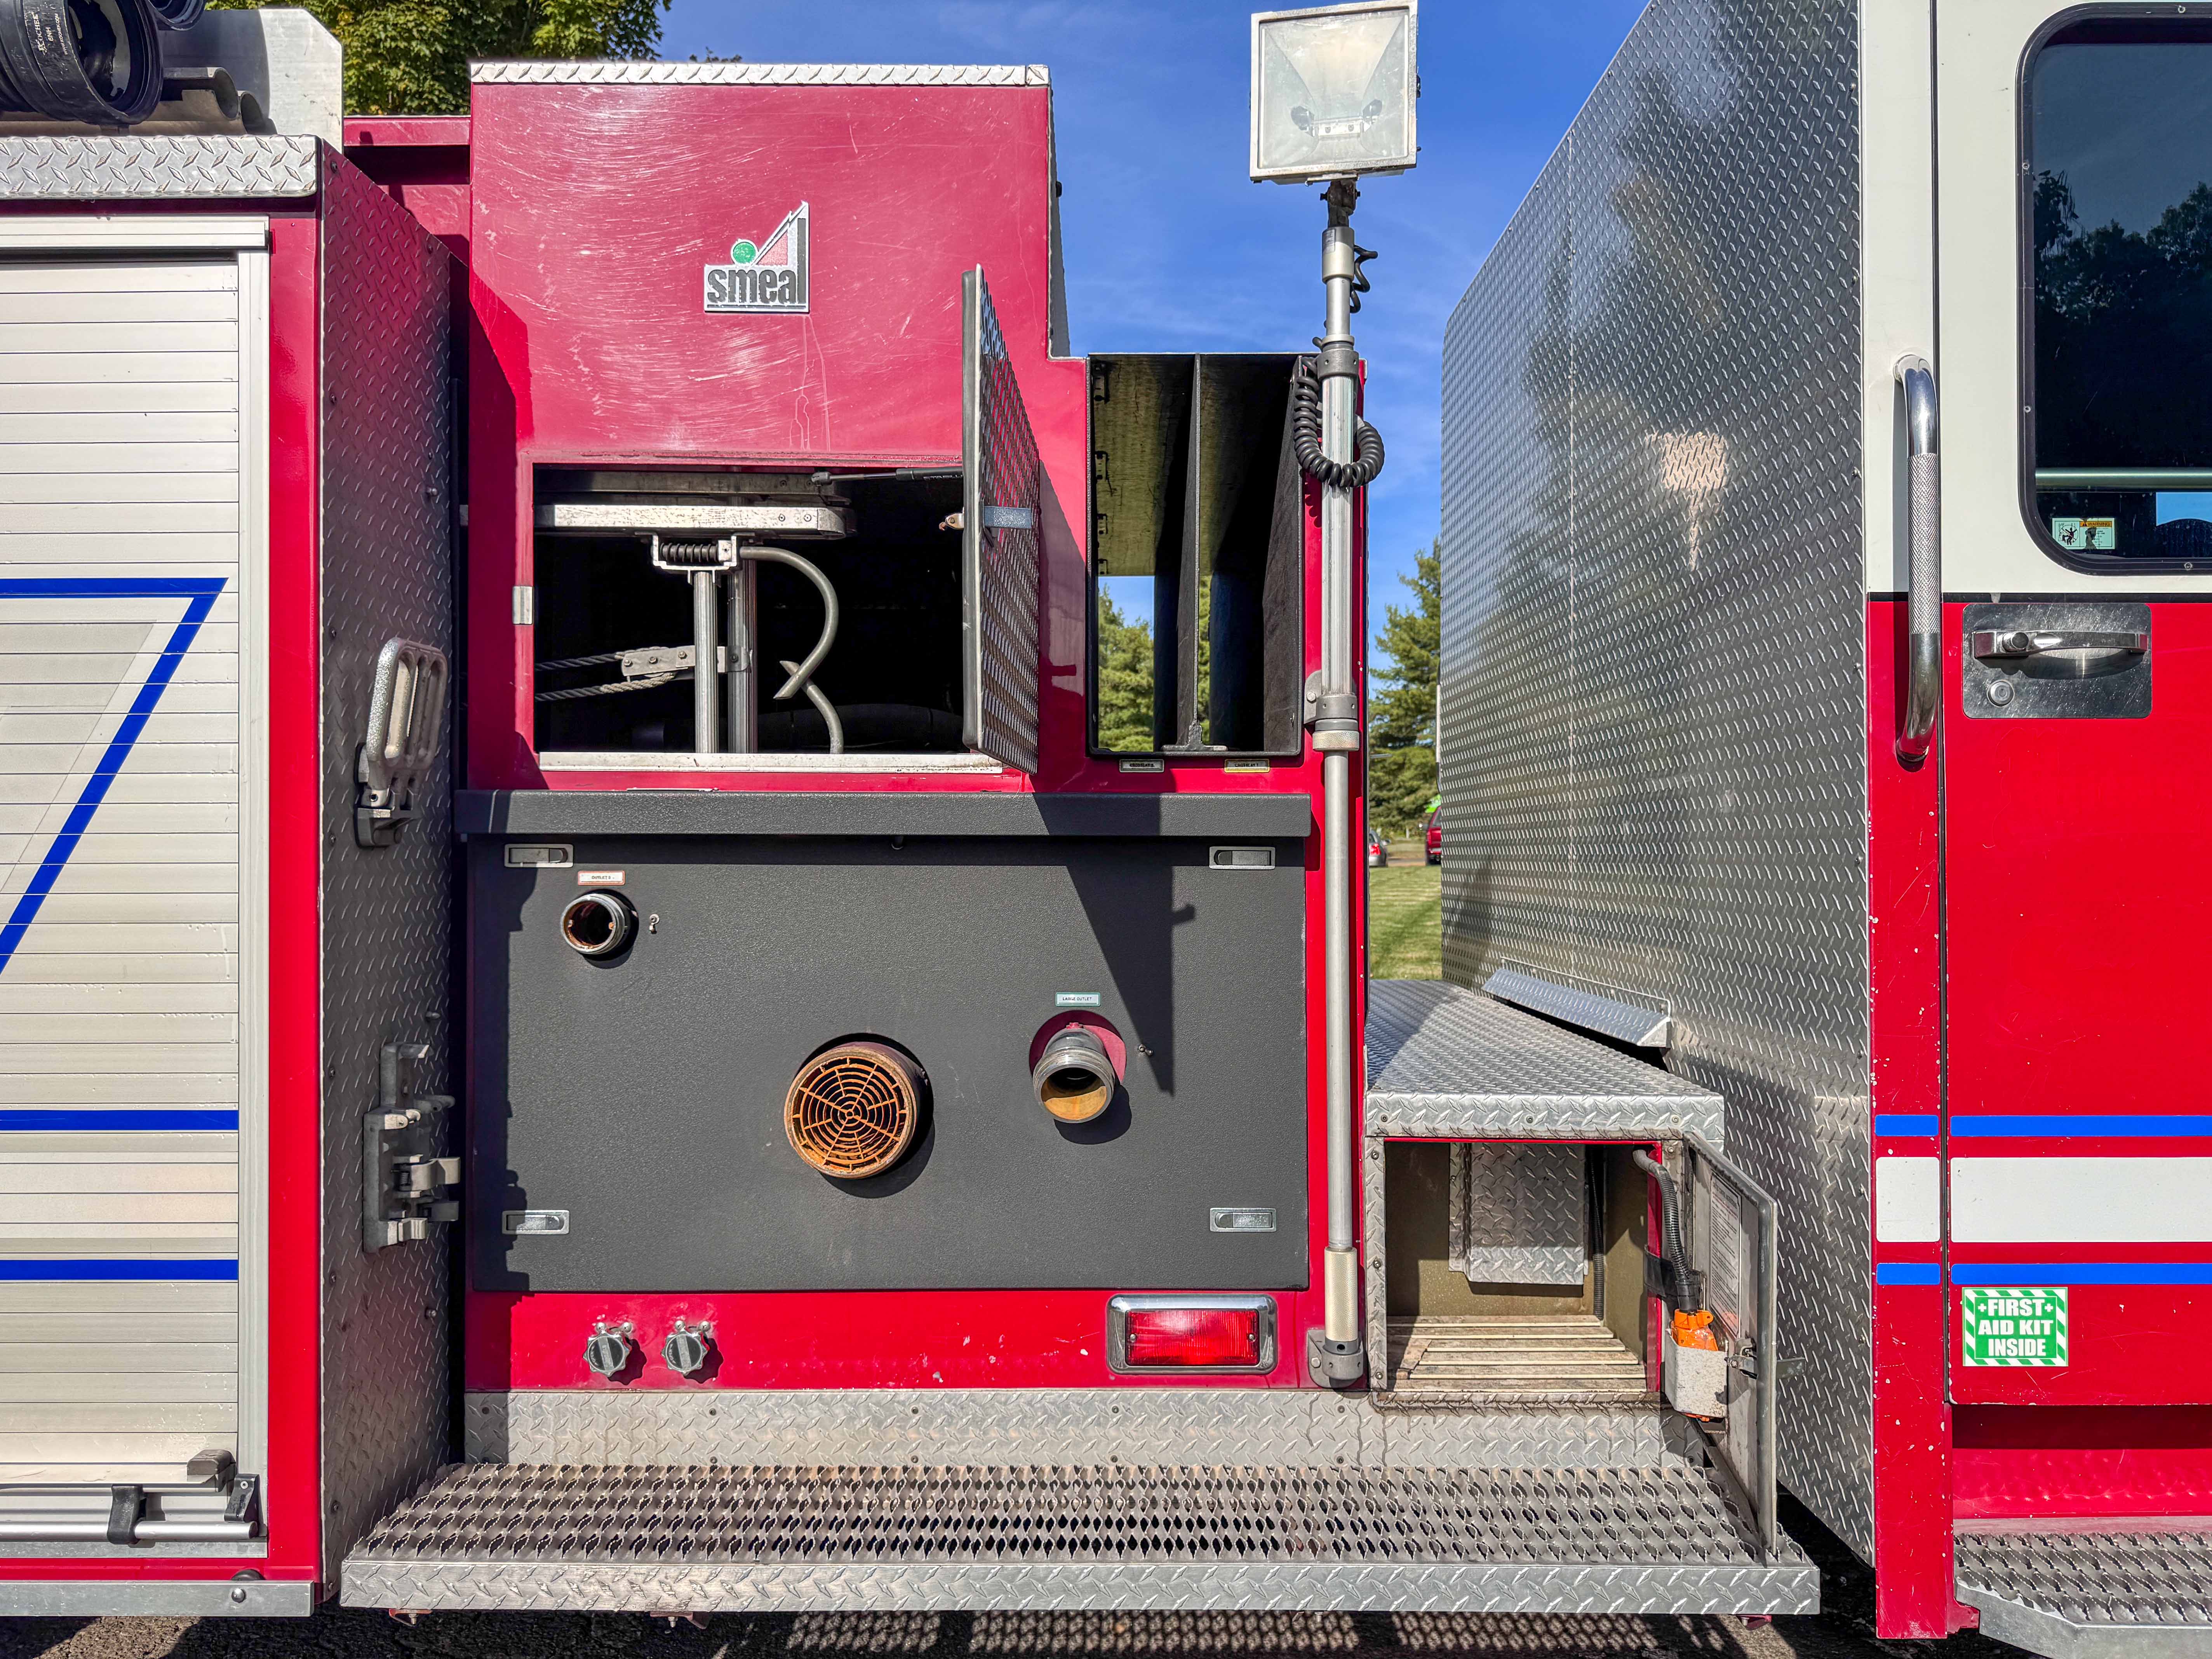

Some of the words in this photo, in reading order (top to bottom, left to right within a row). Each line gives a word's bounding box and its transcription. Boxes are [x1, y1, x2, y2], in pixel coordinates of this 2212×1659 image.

[45, 27, 54, 41] 6NH
[707, 218, 806, 304] smeal
[1988, 1299, 2045, 1316] FIRST
[1978, 1320, 2014, 1335] AID
[2019, 1320, 2053, 1335] KIT
[1988, 1339, 2046, 1356] INSIDE
